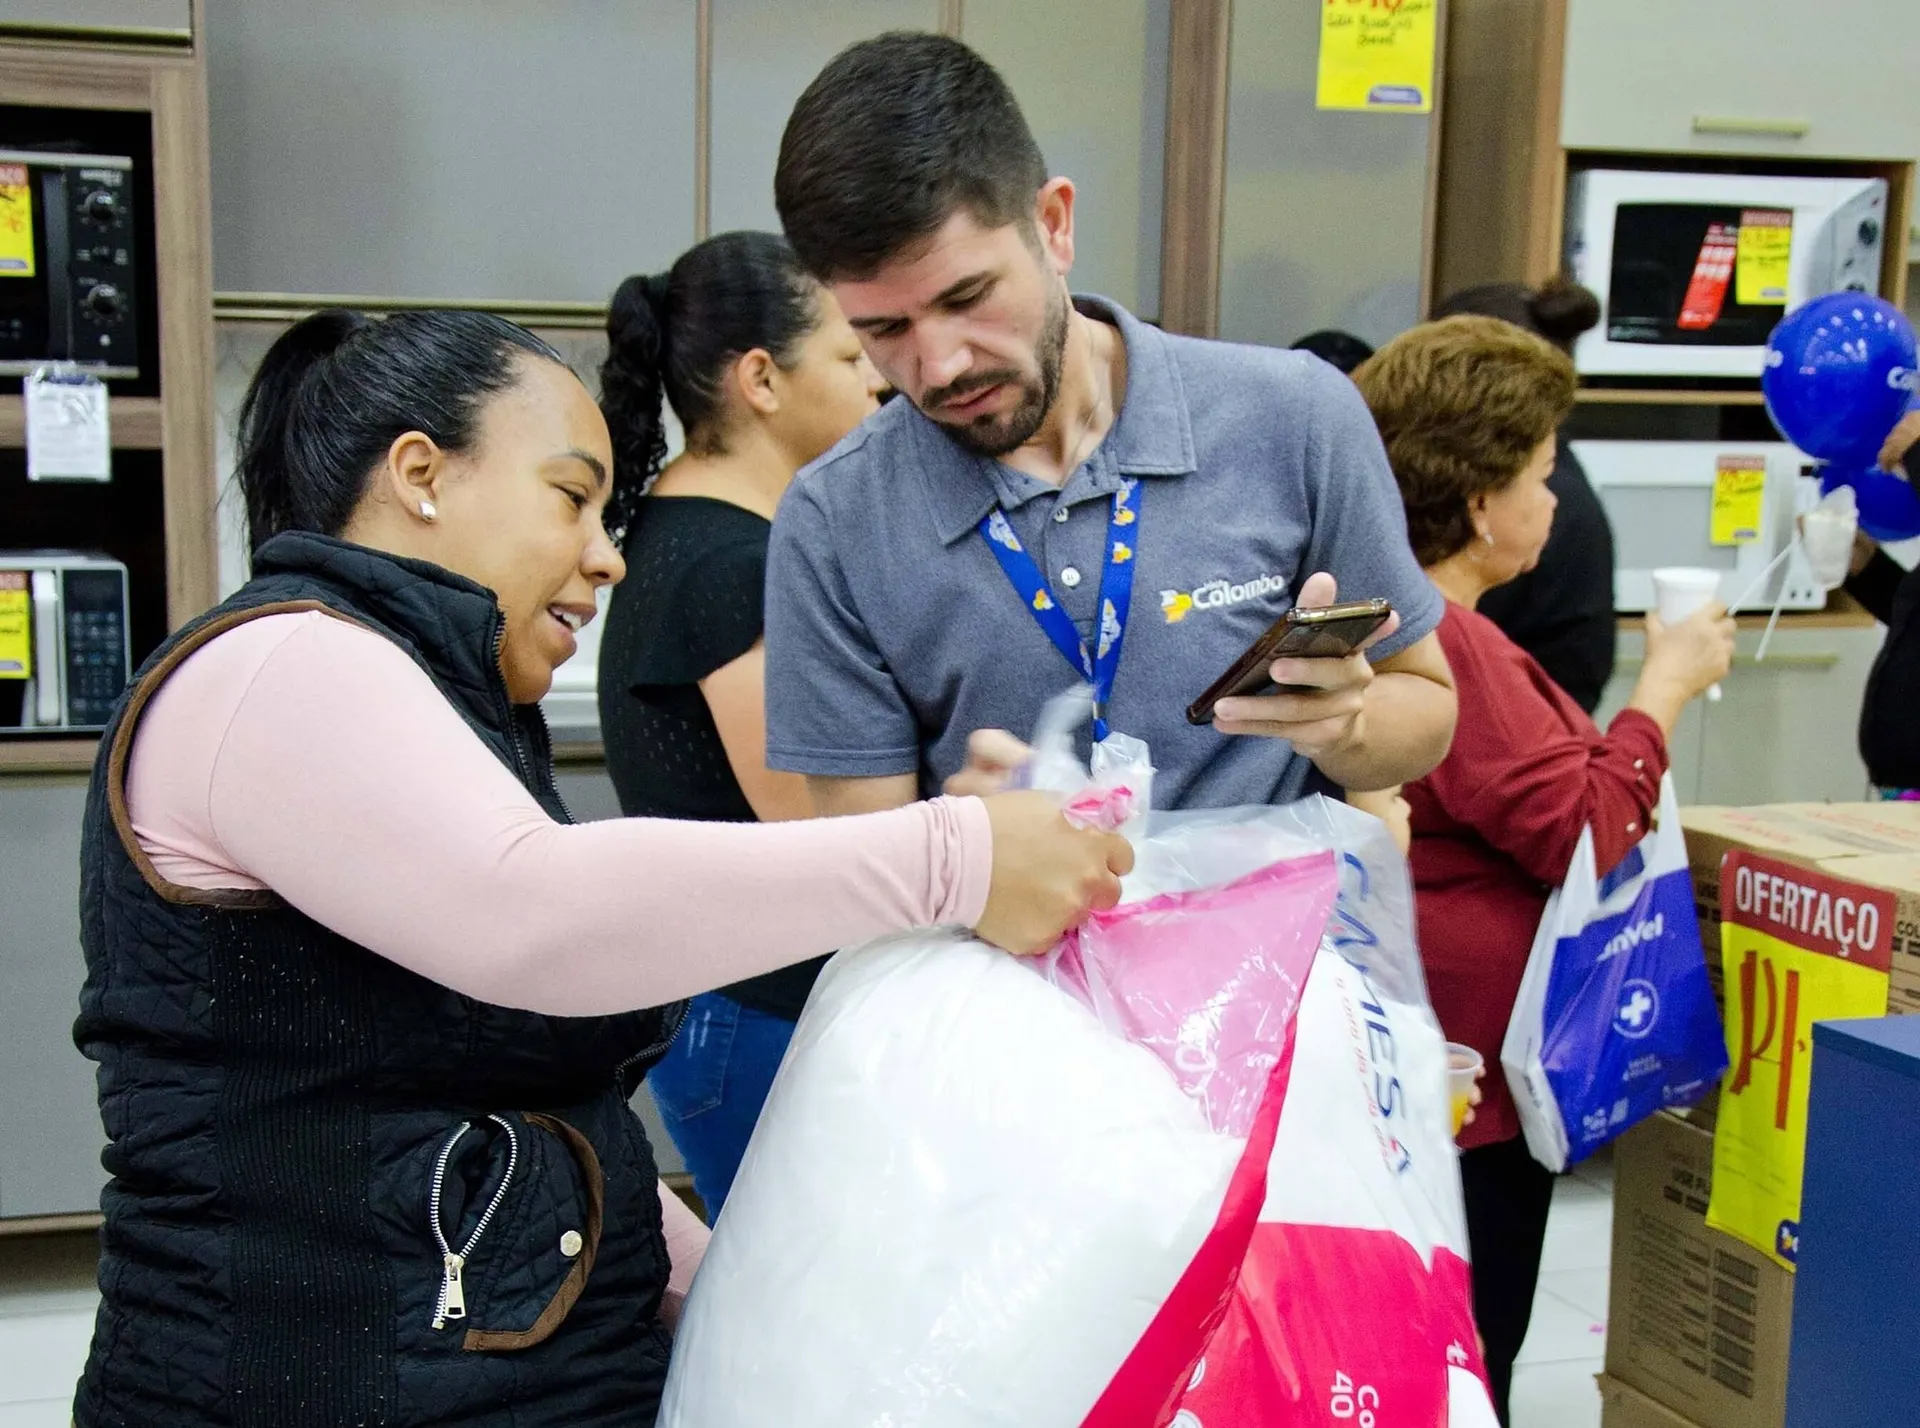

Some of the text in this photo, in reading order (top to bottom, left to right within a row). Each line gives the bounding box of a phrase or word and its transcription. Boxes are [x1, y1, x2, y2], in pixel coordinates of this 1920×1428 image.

[1192, 573, 1285, 610] Colombo
[1735, 865, 1880, 957] OFERTAÇO
[1330, 1370, 1355, 1419] 40
